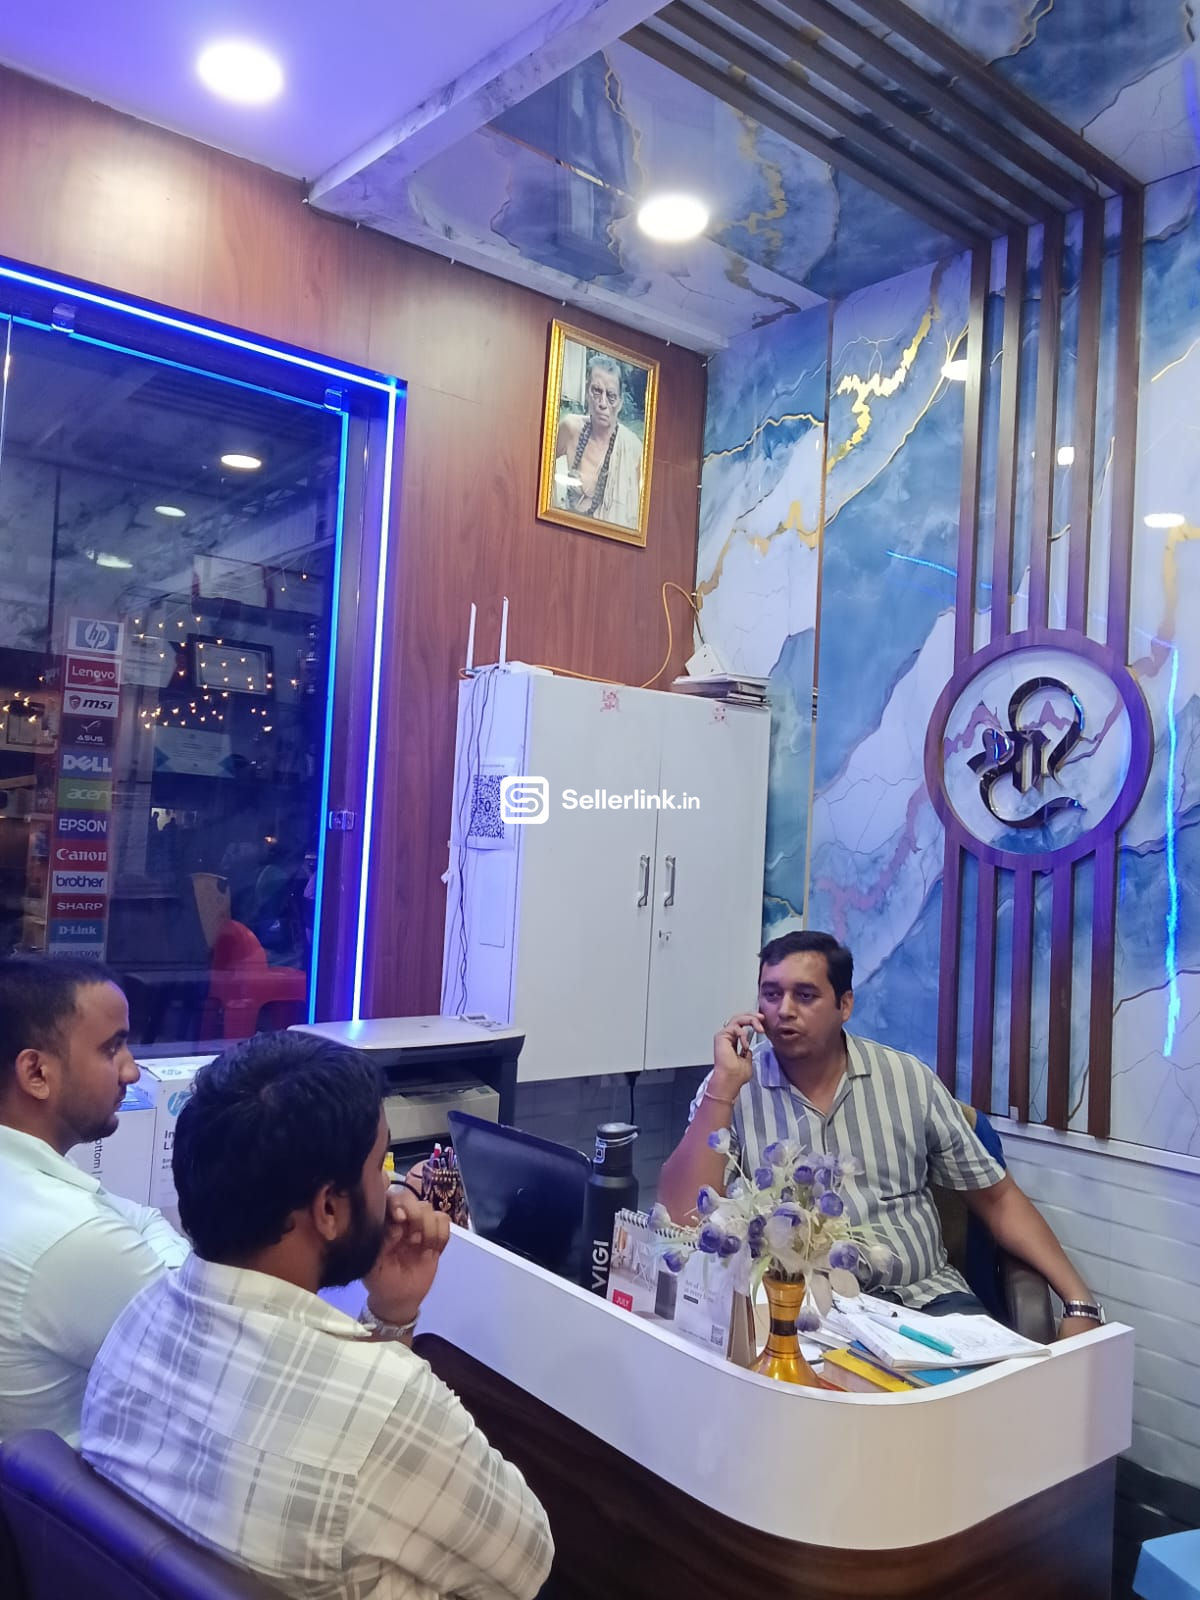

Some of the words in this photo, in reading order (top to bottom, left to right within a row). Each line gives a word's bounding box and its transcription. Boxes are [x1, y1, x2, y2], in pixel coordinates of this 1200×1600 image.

[87, 621, 107, 649] hp
[72, 665, 115, 680] Lenovo
[82, 699, 113, 710] msi
[63, 754, 112, 773] DELL
[67, 788, 112, 800] acer
[58, 818, 107, 832] EPSON
[56, 848, 107, 861] Canon
[56, 875, 104, 888] brother
[56, 902, 103, 911] SHARP
[59, 925, 97, 935] D-Link
[592, 1240, 609, 1289] VIGI
